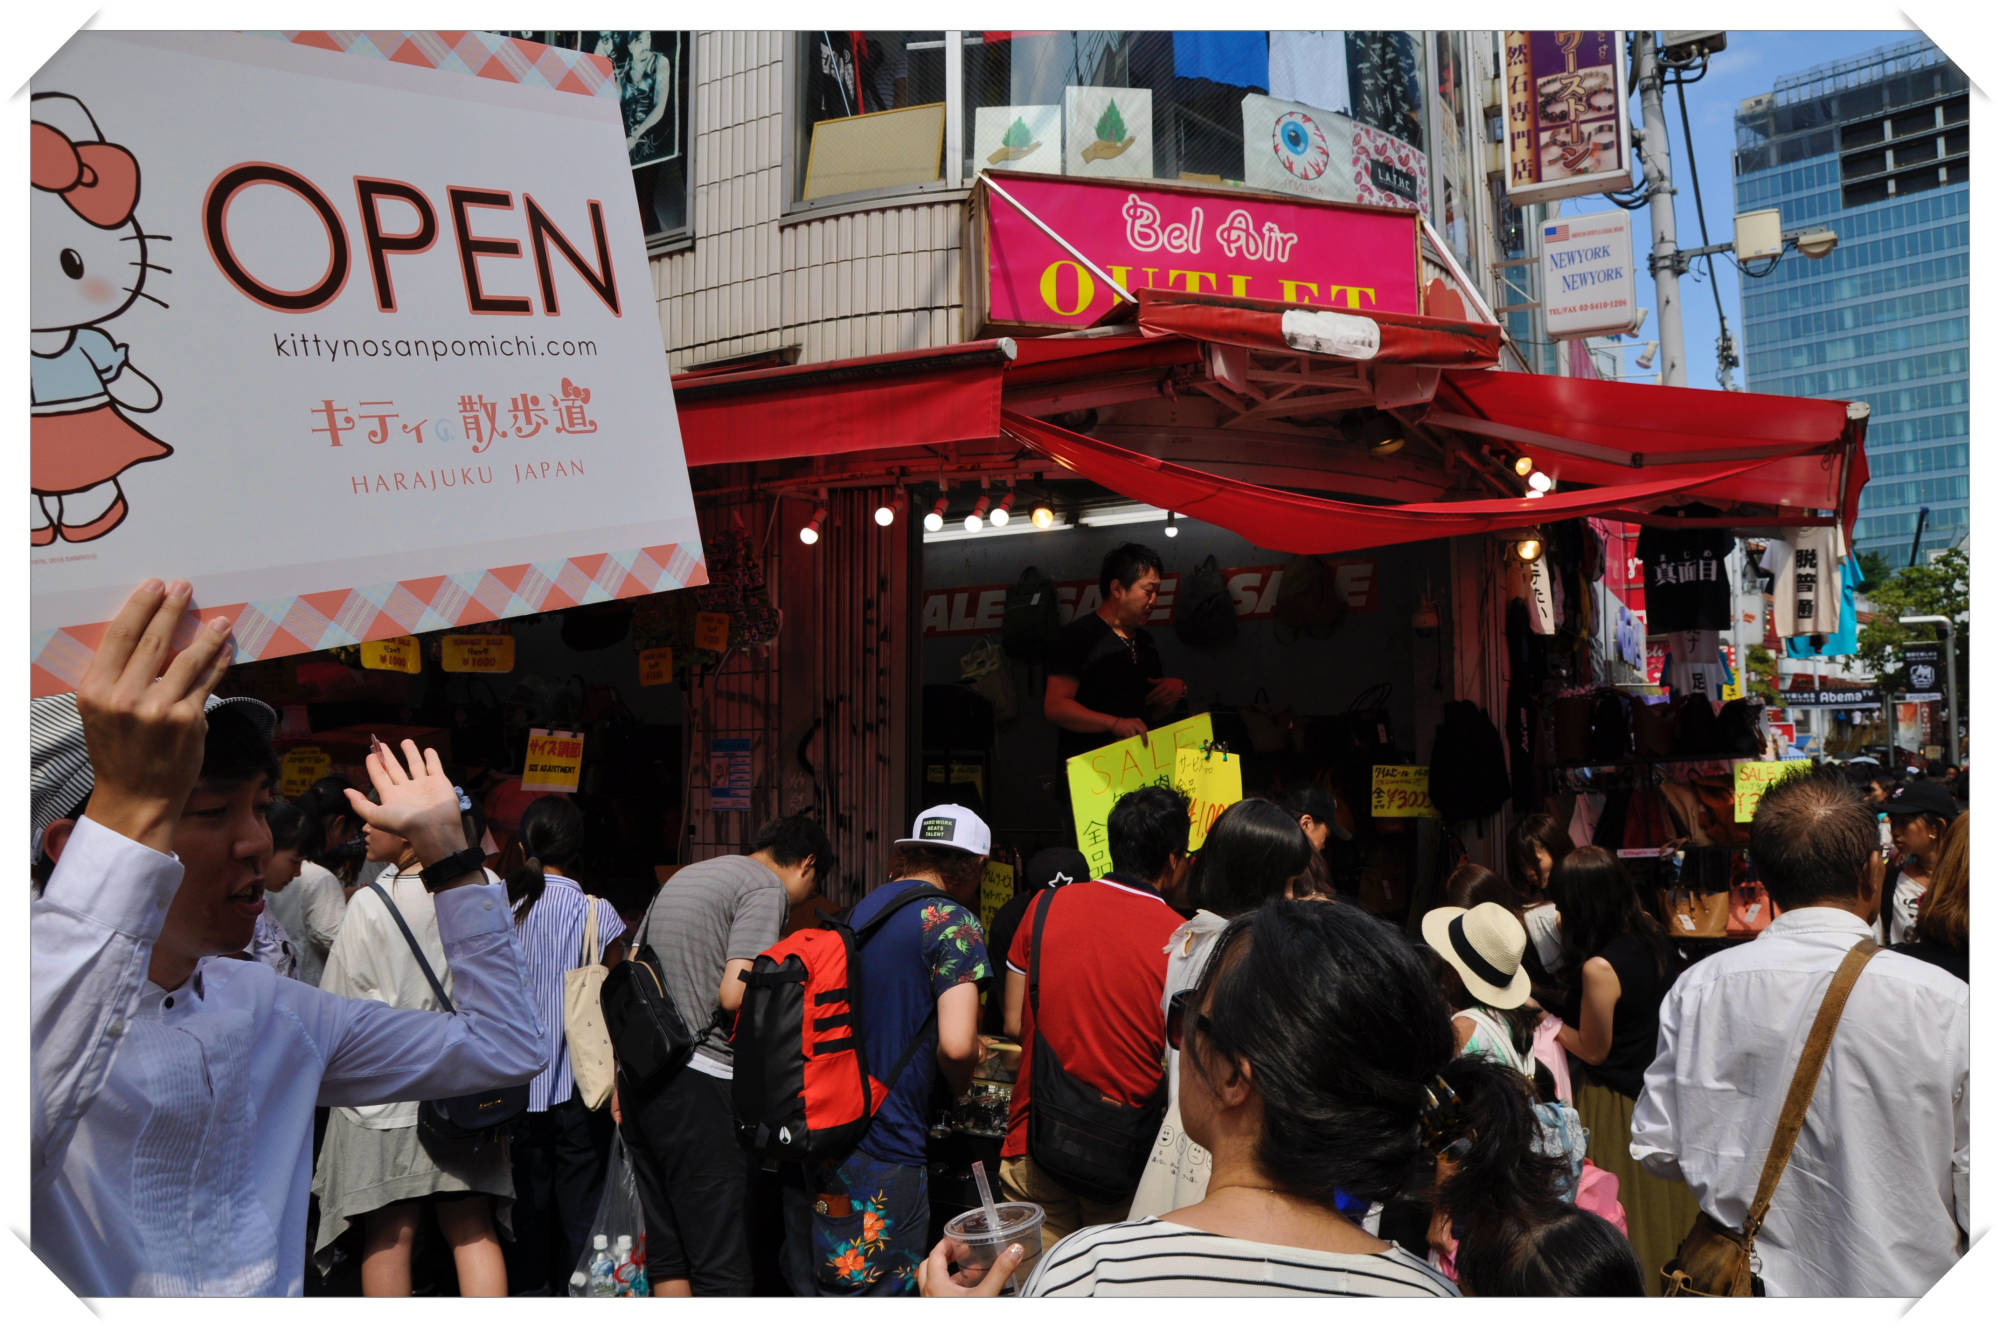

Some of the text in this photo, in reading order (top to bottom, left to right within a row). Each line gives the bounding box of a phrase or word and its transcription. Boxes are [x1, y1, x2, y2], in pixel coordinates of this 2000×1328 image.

[1505, 31, 1533, 180] 然石専門店
[202, 160, 622, 318] OPEN
[1122, 194, 1298, 262] Bel Air
[1550, 245, 1612, 272] NEWYORK
[1562, 266, 1625, 293] NEWYORK
[273, 333, 598, 362] kittynosanpomichi.com
[310, 385, 598, 454] キティの散歩道
[351, 459, 585, 495] HARAJUKU JAPAN
[924, 563, 1374, 633] ALE SAE SAE
[1654, 560, 1718, 587] 真面目
[1796, 549, 1817, 619] 脱普通
[1091, 726, 1197, 795] SALE
[1739, 765, 1776, 782] SALE
[1187, 798, 1233, 839] ¥1,00
